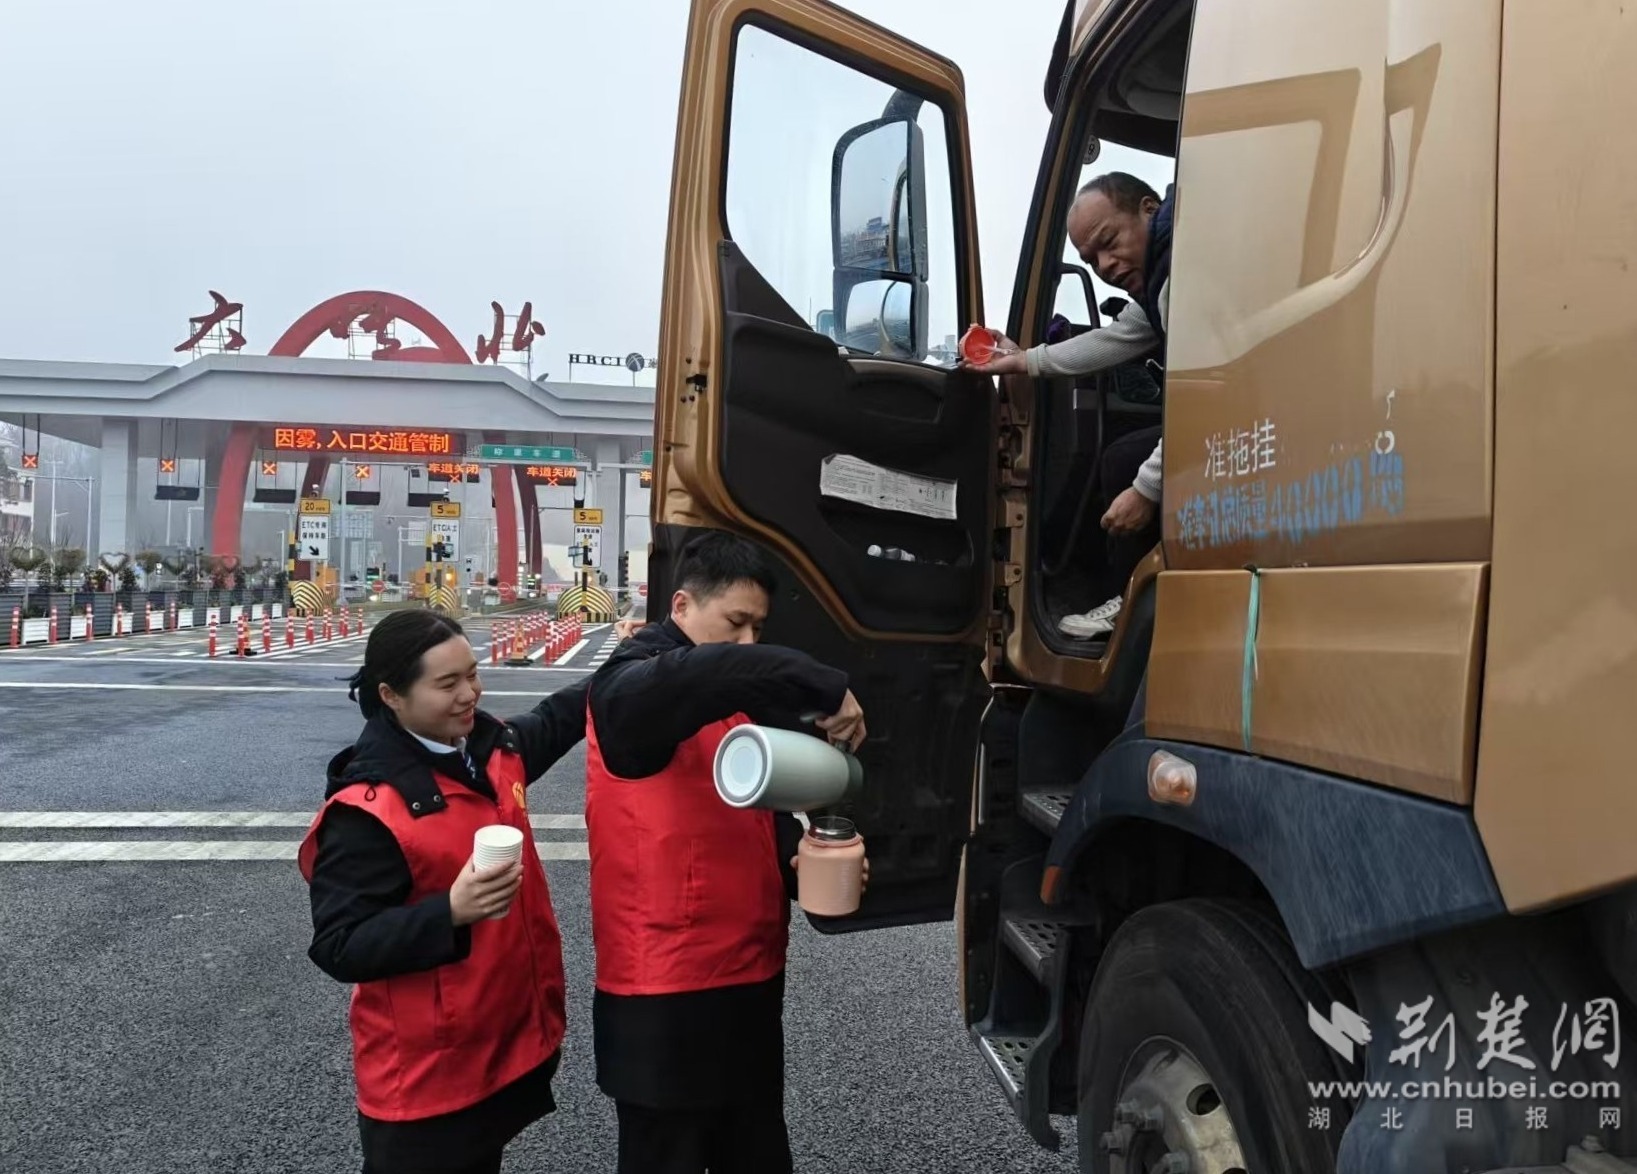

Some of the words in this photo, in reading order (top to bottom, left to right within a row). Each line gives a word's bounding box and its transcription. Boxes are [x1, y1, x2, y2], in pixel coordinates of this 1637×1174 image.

[275, 428, 449, 453] 因雾,入口交通管制
[1204, 418, 1276, 480] 准拖挂
[428, 463, 479, 476] 车道关闭
[526, 466, 577, 478] 车道关闭
[305, 502, 314, 511] 20
[437, 505, 443, 514] 5
